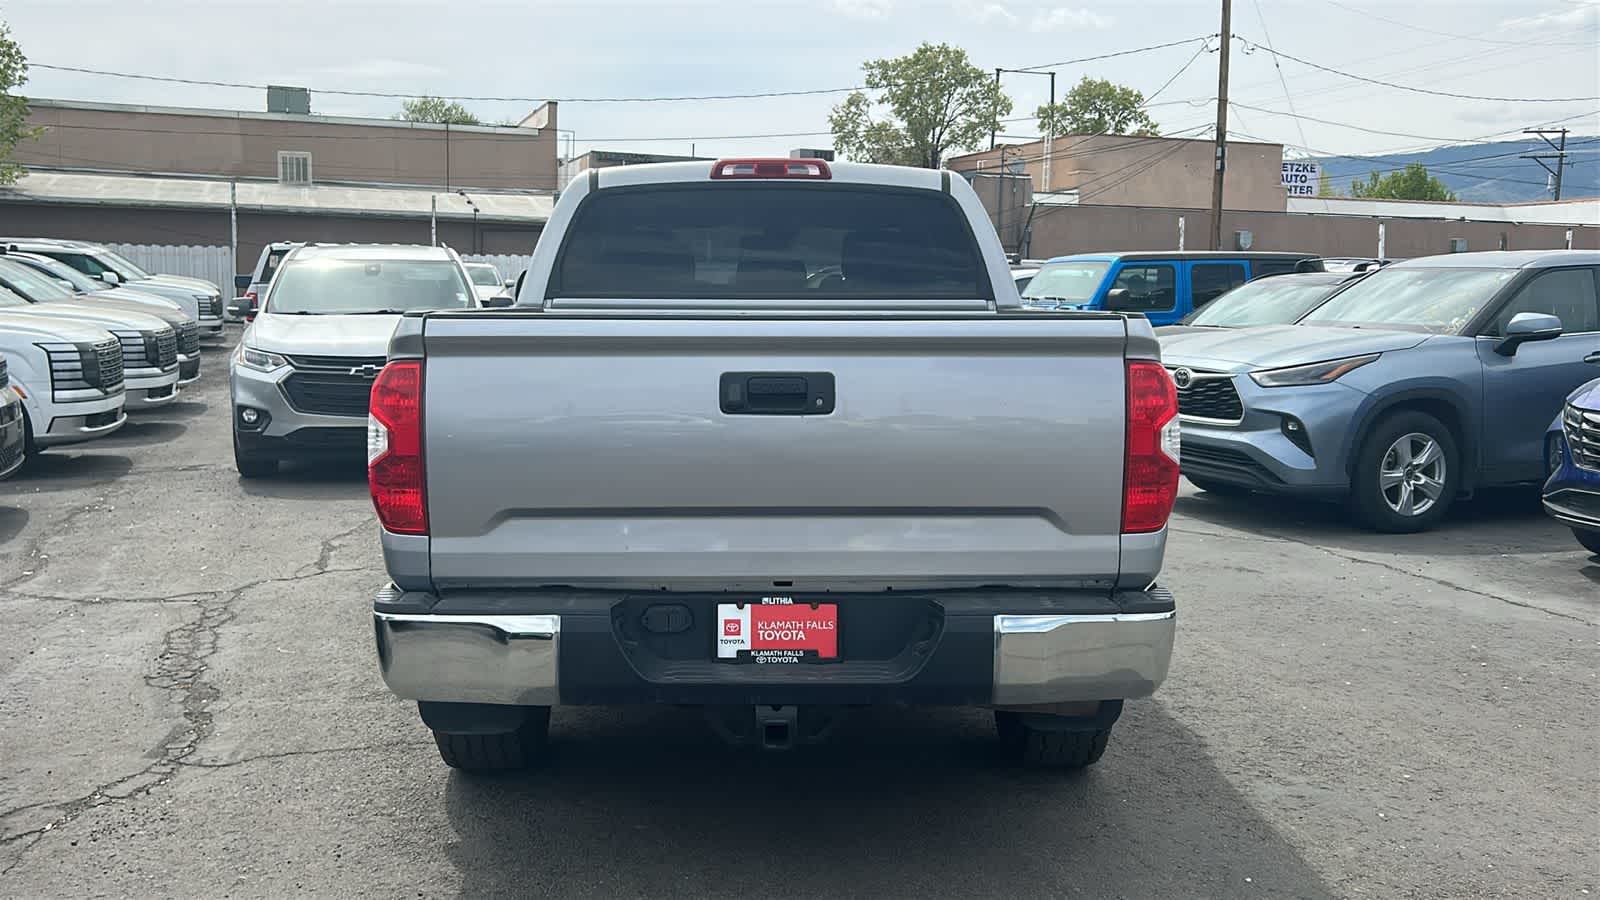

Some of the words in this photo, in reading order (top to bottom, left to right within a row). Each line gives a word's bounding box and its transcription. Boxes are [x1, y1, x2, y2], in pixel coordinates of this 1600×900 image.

[769, 597, 793, 605] LITHIA
[758, 621, 803, 630] KLAMATH
[806, 621, 834, 630] FALLS
[758, 630, 806, 641] TOYOTA
